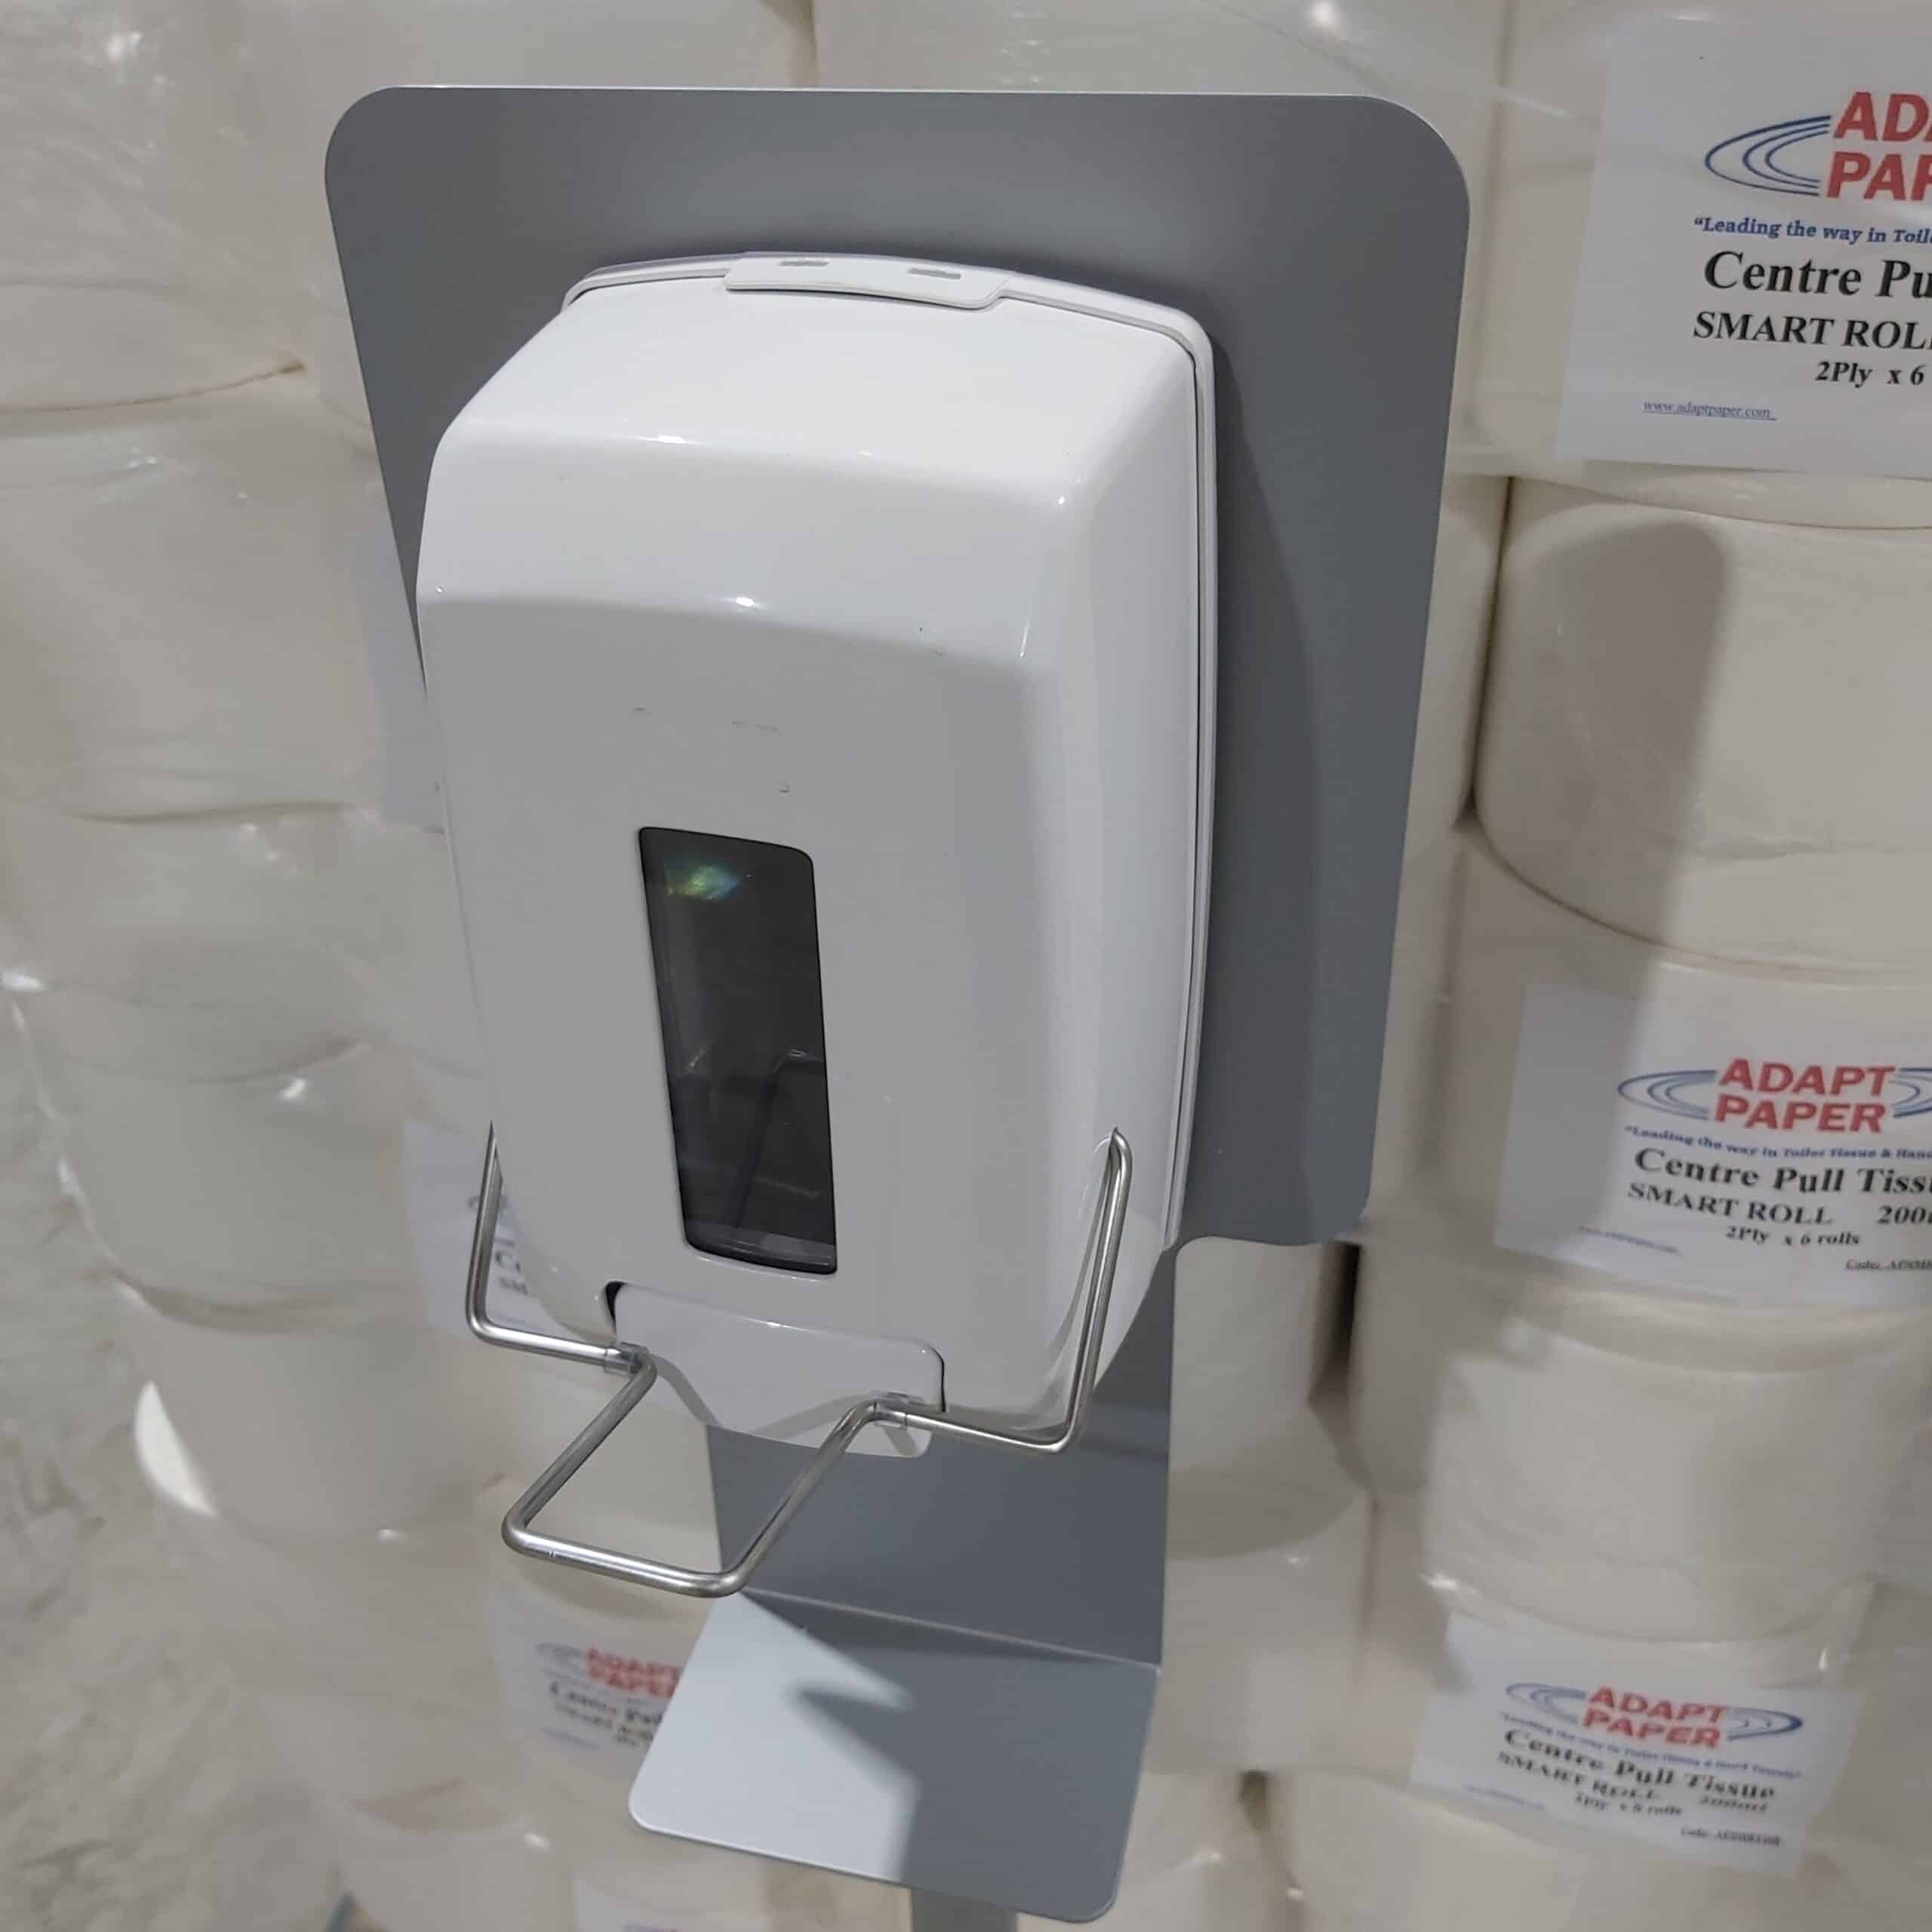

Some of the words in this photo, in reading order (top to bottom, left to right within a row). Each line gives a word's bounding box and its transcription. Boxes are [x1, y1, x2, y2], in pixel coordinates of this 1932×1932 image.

[1834, 91, 1932, 142] AD
[1786, 220, 1817, 238] the
[1823, 227, 1862, 247] way
[1867, 227, 1886, 243] in
[1704, 251, 1862, 296] Centre
[1693, 311, 1835, 345] SMART
[1840, 318, 1932, 350] ROL
[1815, 361, 1872, 389] 2Ply
[1886, 369, 1902, 385] x
[1910, 365, 1926, 386] 6
[1642, 400, 1772, 420] www.adaptpaper.com
[1718, 1058, 1896, 1097] ADAPT
[1715, 1094, 1886, 1134] PAPER
[1634, 1147, 1760, 1187] Centre
[1774, 1168, 1845, 1192] Pull
[1628, 1182, 1740, 1217] SMART
[1747, 1201, 1833, 1225] ROLL
[1726, 1225, 1770, 1244] 2Ply
[1800, 1232, 1811, 1246] 6
[1817, 1231, 1861, 1246] rolls
[1588, 1687, 1728, 1723] ADAPT
[1583, 1708, 1721, 1748] PAPER
[1505, 1729, 1604, 1770] Centre
[1616, 1760, 1675, 1785] Pull
